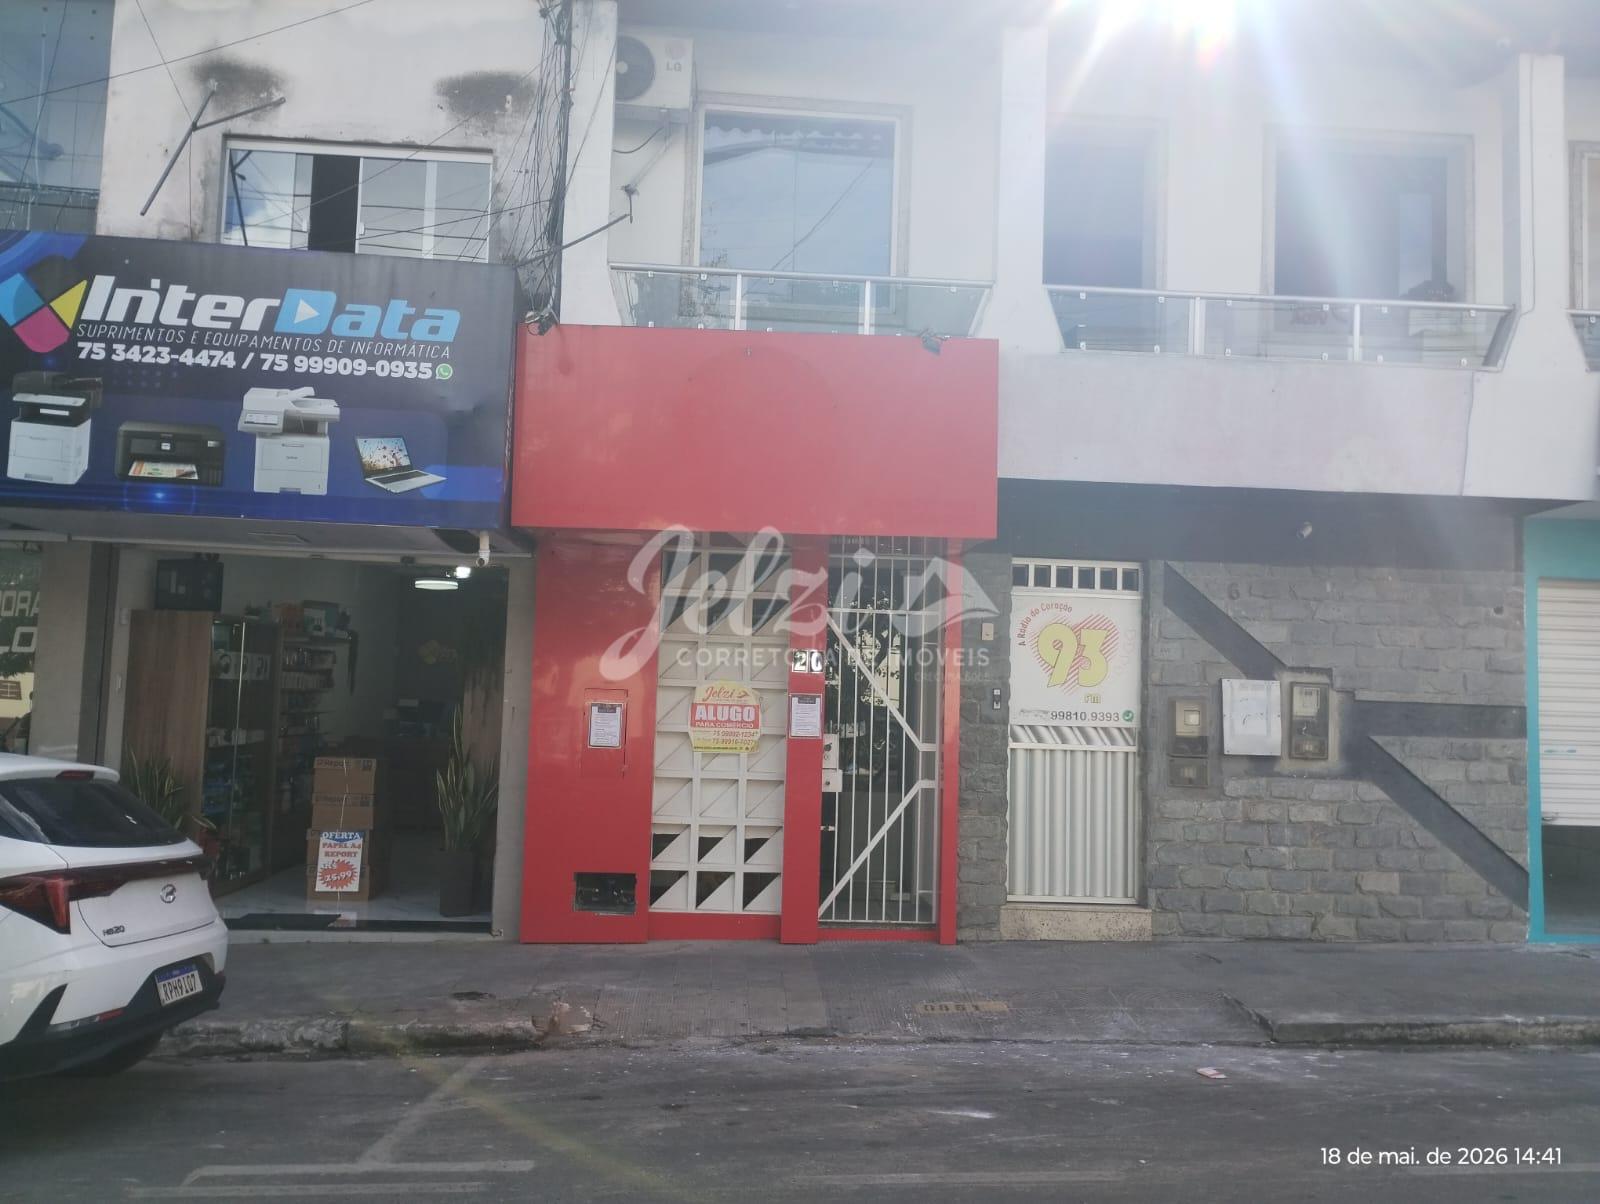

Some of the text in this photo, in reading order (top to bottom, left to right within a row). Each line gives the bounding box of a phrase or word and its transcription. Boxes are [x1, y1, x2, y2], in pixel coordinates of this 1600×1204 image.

[666, 61, 682, 72] LG
[77, 323, 450, 359] SUPRIMENTOS E EQUIPAMENTOS DE INFORMÁTICA
[77, 341, 106, 360] 75
[111, 342, 236, 369] 3423-4474
[260, 353, 288, 371] 75
[294, 355, 433, 379] 99909-0935
[1036, 622, 1109, 688] 93
[695, 704, 755, 722] ALUGO
[322, 831, 361, 841] OFERTA
